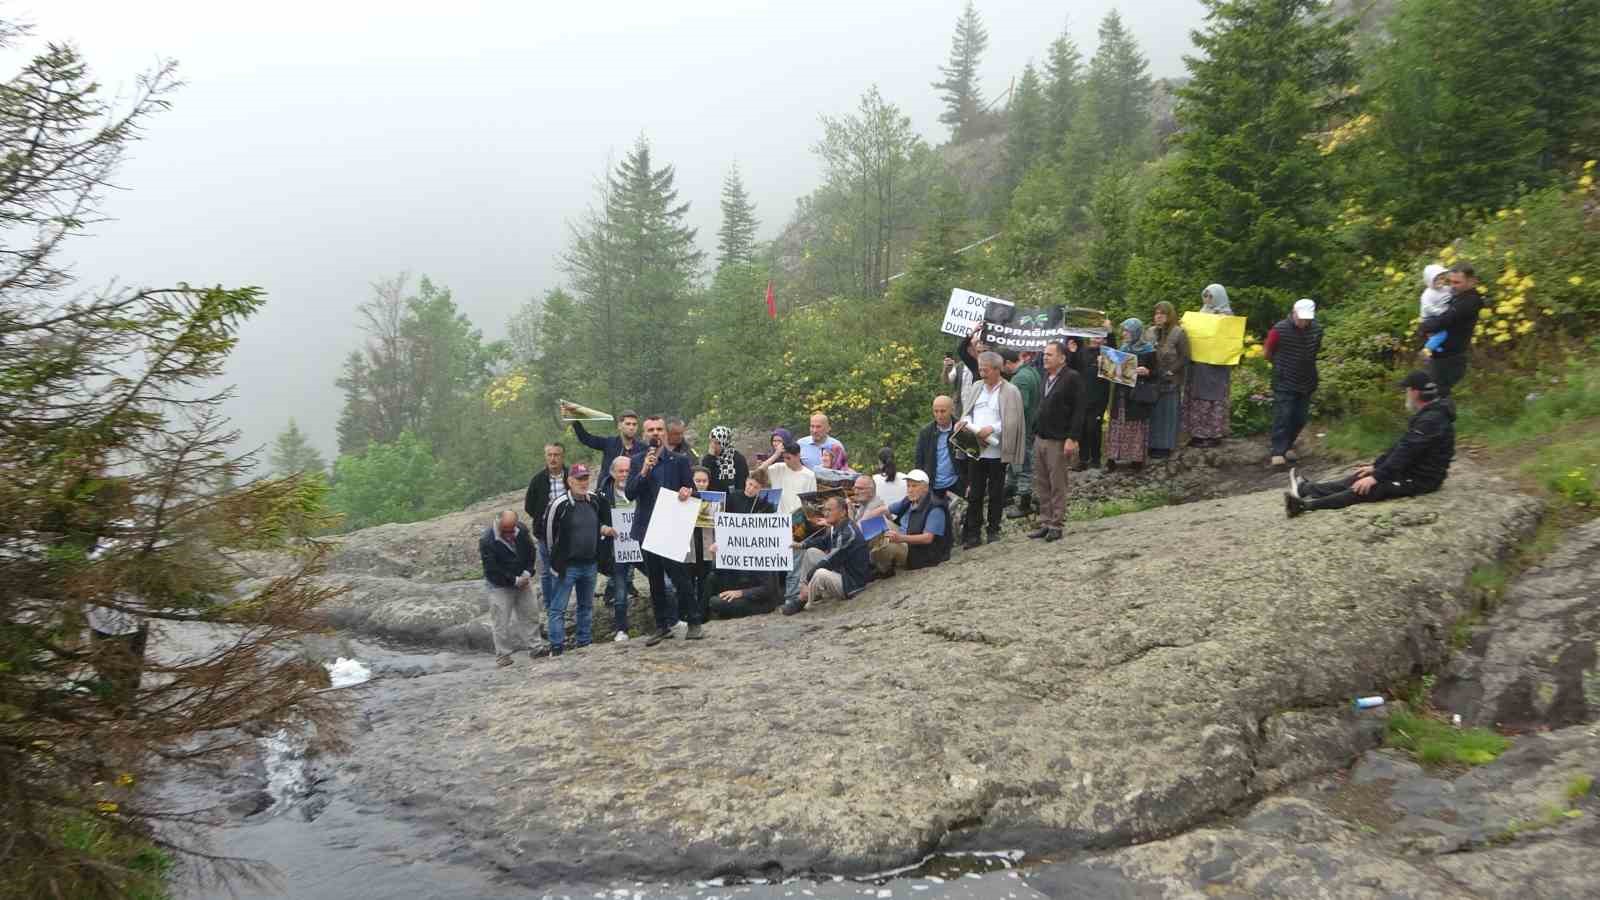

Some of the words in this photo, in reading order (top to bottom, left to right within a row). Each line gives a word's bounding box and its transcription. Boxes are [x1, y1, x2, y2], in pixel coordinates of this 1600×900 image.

[968, 296, 990, 308] DOĞ
[951, 307, 982, 322] KATLİA
[945, 322, 973, 336] DURD
[718, 515, 790, 529] ATALARIMIZIN
[619, 532, 632, 543] BA
[727, 536, 780, 548] ANILARINI
[720, 554, 741, 566] YOK
[743, 553, 788, 567] ETMEYİN
